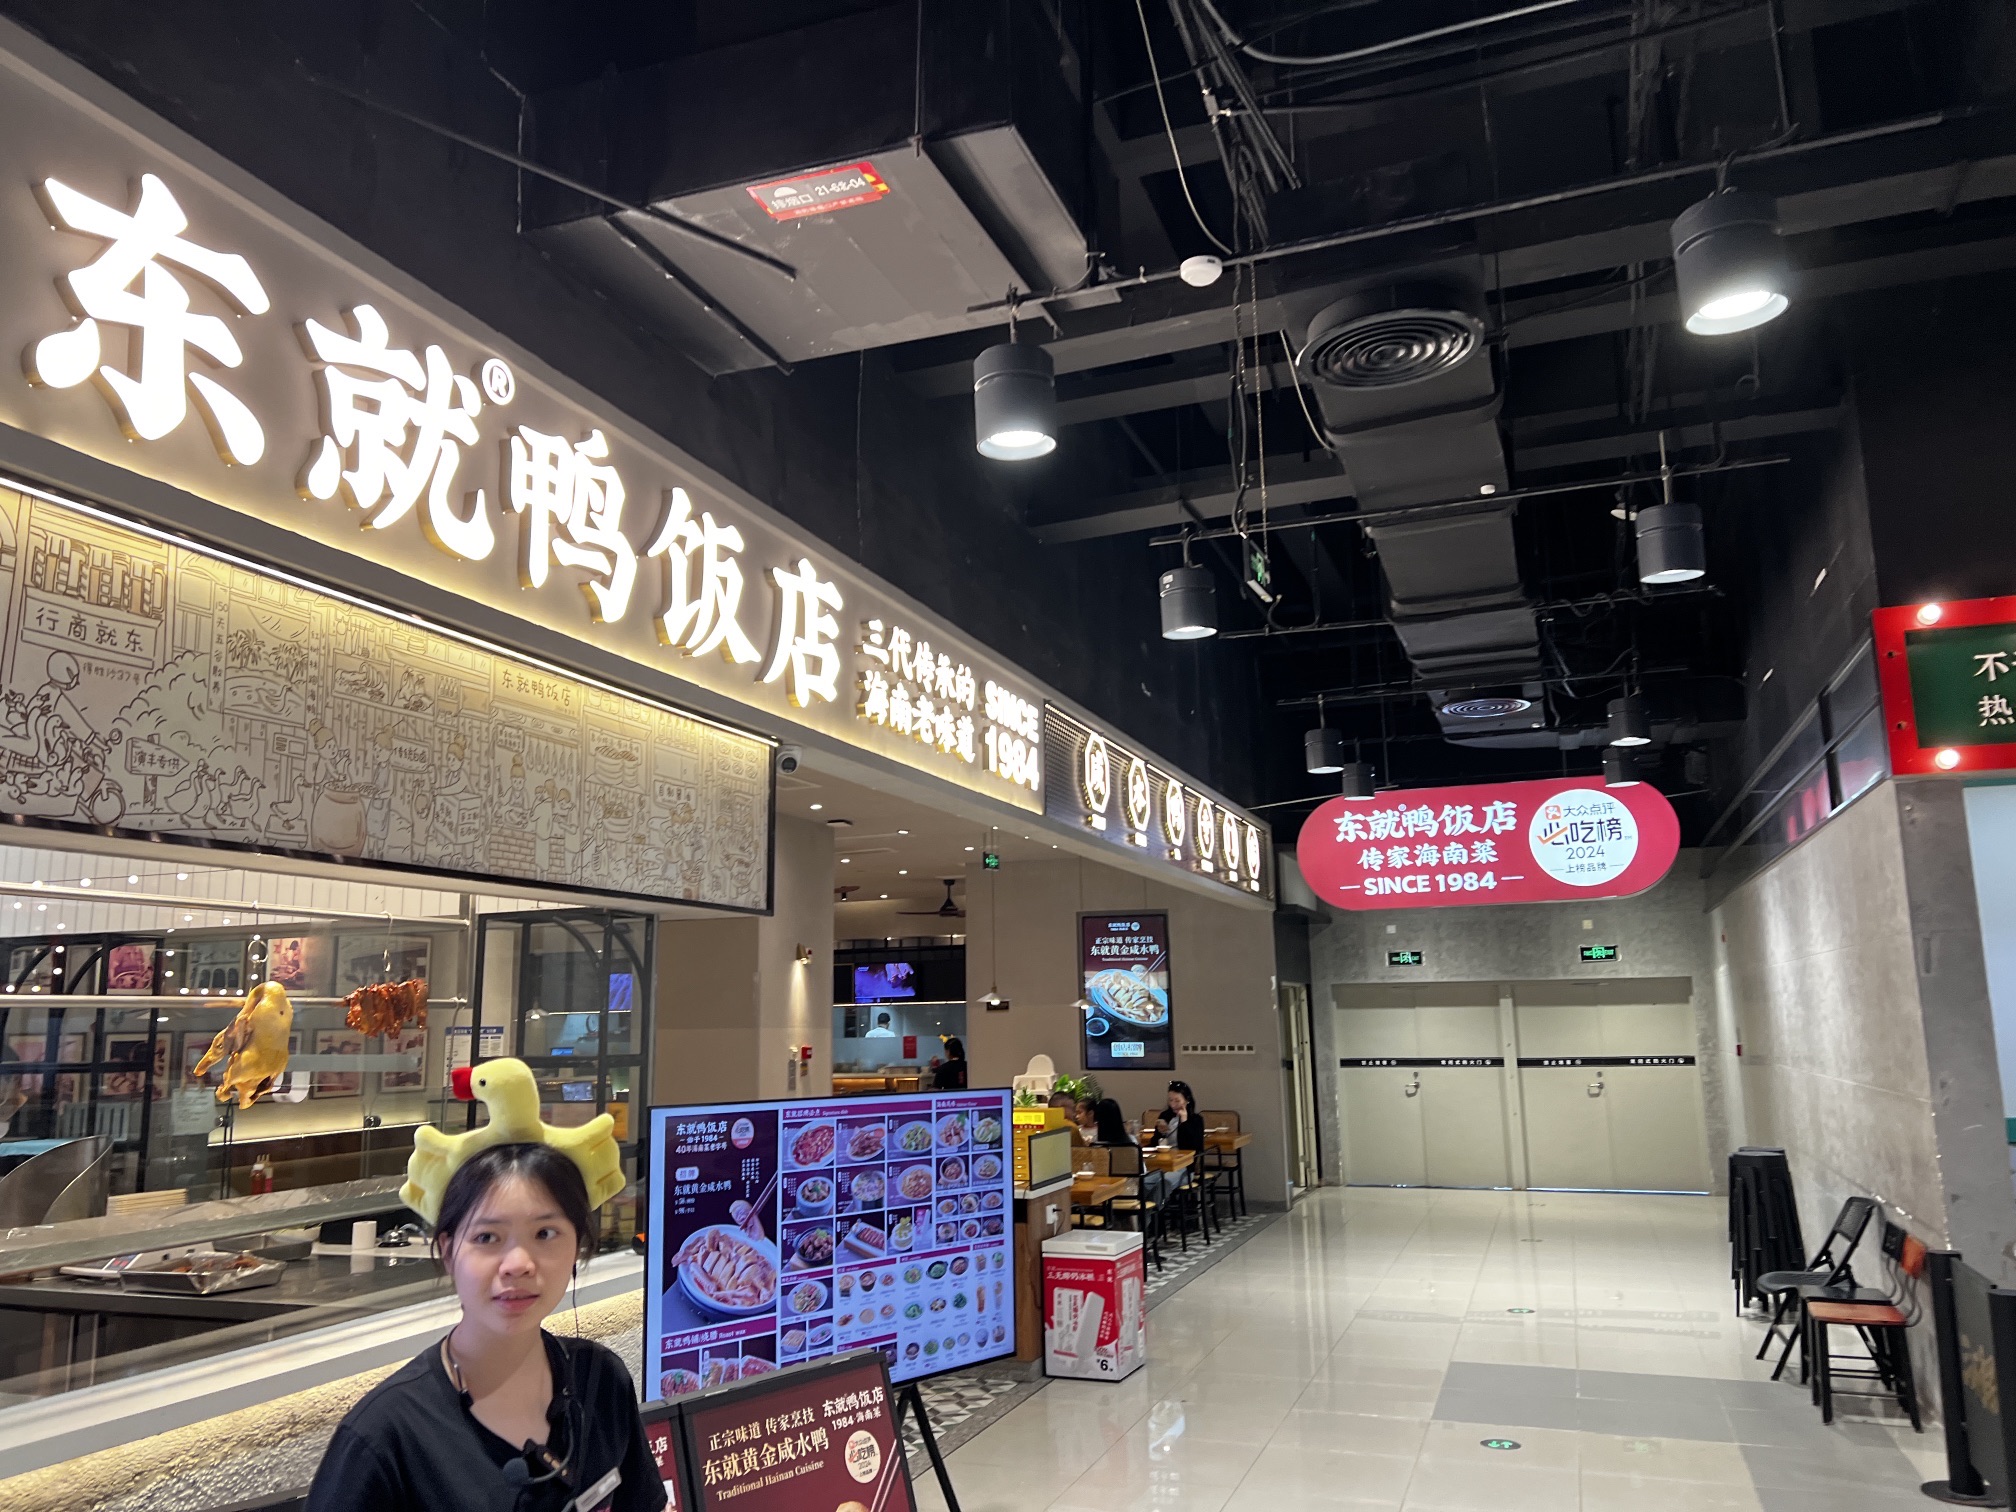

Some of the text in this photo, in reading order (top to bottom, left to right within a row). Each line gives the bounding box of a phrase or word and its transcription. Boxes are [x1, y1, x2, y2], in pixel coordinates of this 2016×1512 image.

[34, 173, 843, 708] 东就鸭饭店
[862, 619, 976, 711] 三代传承的
[501, 669, 572, 706] 东就鸭饭店
[863, 669, 976, 763] 海南老味道
[985, 680, 1039, 743] SINCE
[1977, 693, 2015, 727] 热
[984, 725, 1040, 791] 1984
[1333, 800, 1518, 843] 东就鸭饭店
[1563, 802, 1616, 818] 大众点评
[1537, 817, 1622, 846] 必吃榜
[1356, 838, 1499, 871] 传家海南菜
[1565, 845, 1605, 860] 2024
[1565, 862, 1607, 874] 上榜品牌
[1363, 871, 1498, 896] SINCE 1984
[1090, 944, 1160, 956] 东就黄金咸水鸭
[676, 1120, 728, 1136] 东就鸭饭店
[673, 1180, 732, 1196] 东就黄金咸水鸭
[822, 1386, 884, 1418] 东就鸭饭店
[708, 1407, 816, 1452] 正宗味道 传家烹技
[702, 1426, 830, 1487] 东就黄金咸水鸭
[716, 1459, 825, 1501] Traditional Hainan Cuisine
